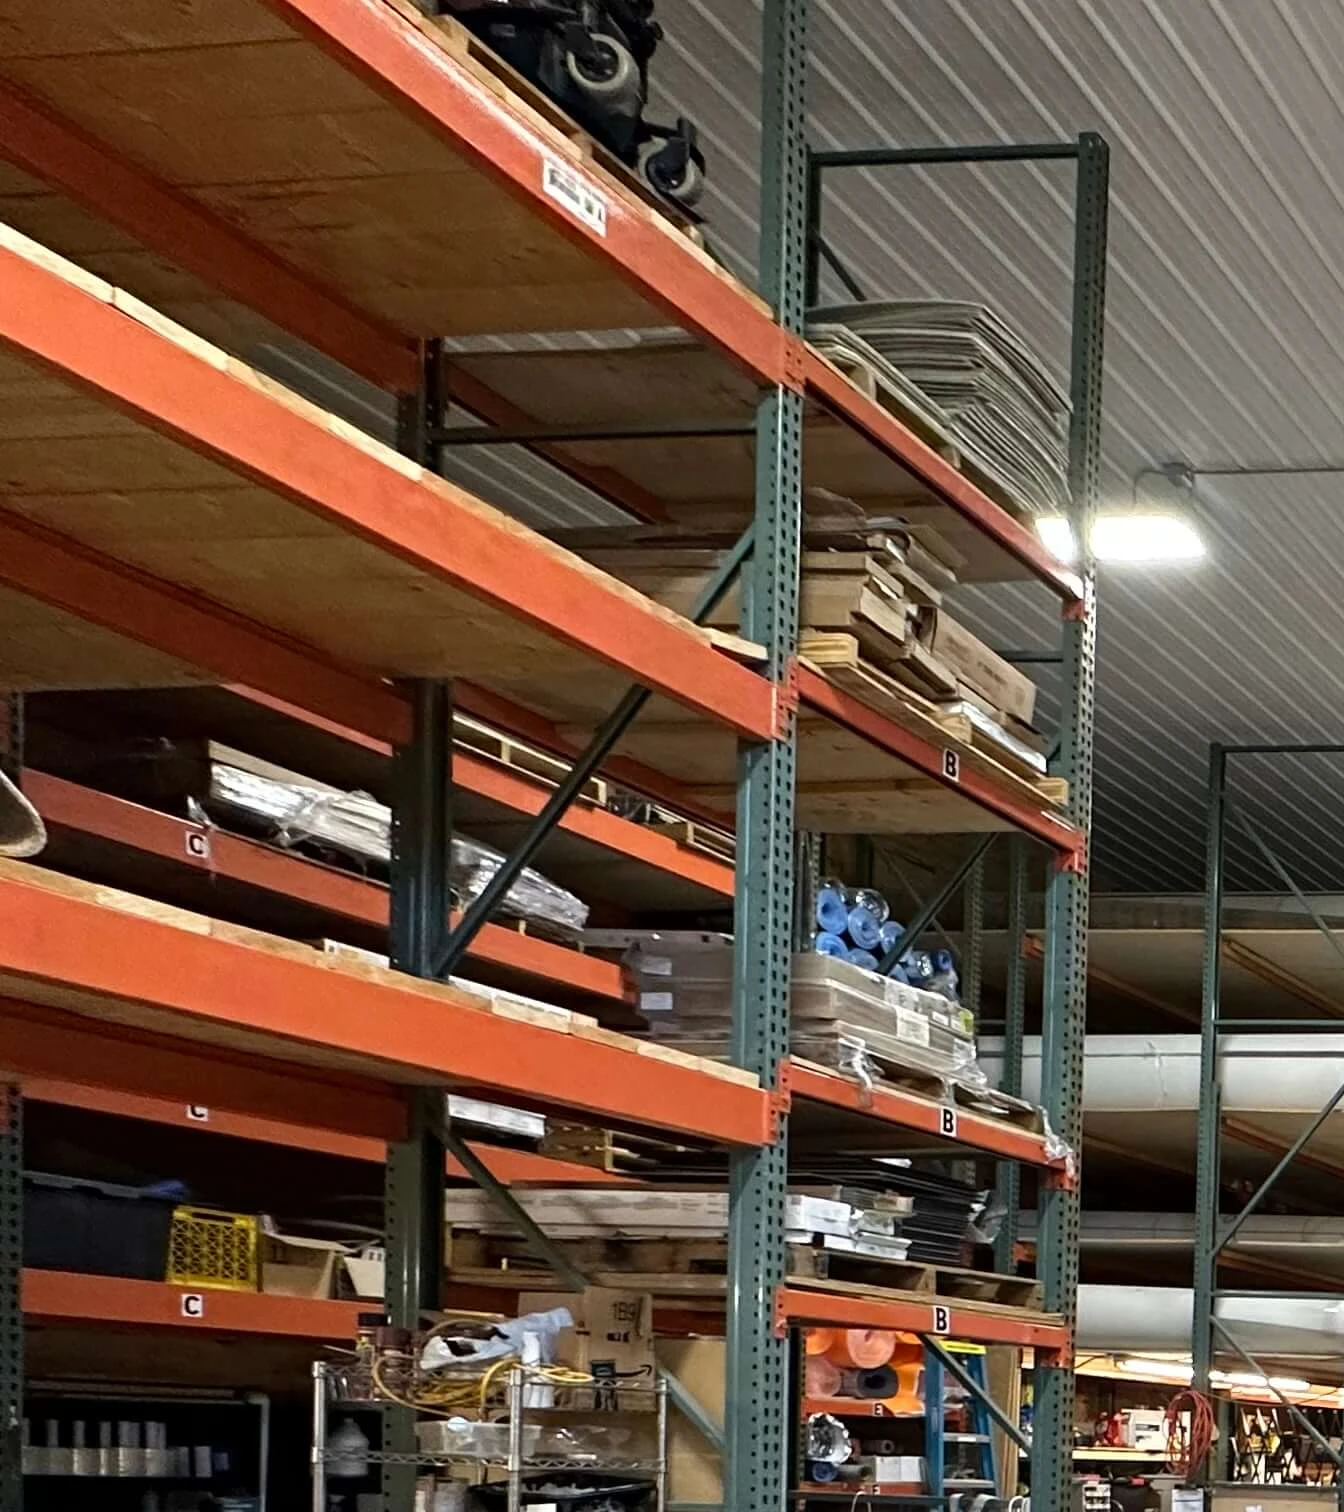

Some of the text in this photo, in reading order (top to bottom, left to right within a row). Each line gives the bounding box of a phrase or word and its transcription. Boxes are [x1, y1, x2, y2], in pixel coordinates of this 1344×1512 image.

[946, 750, 957, 777] B
[189, 835, 204, 855] C
[943, 1109, 954, 1133] B
[185, 1295, 200, 1315] C
[936, 1307, 947, 1331] B
